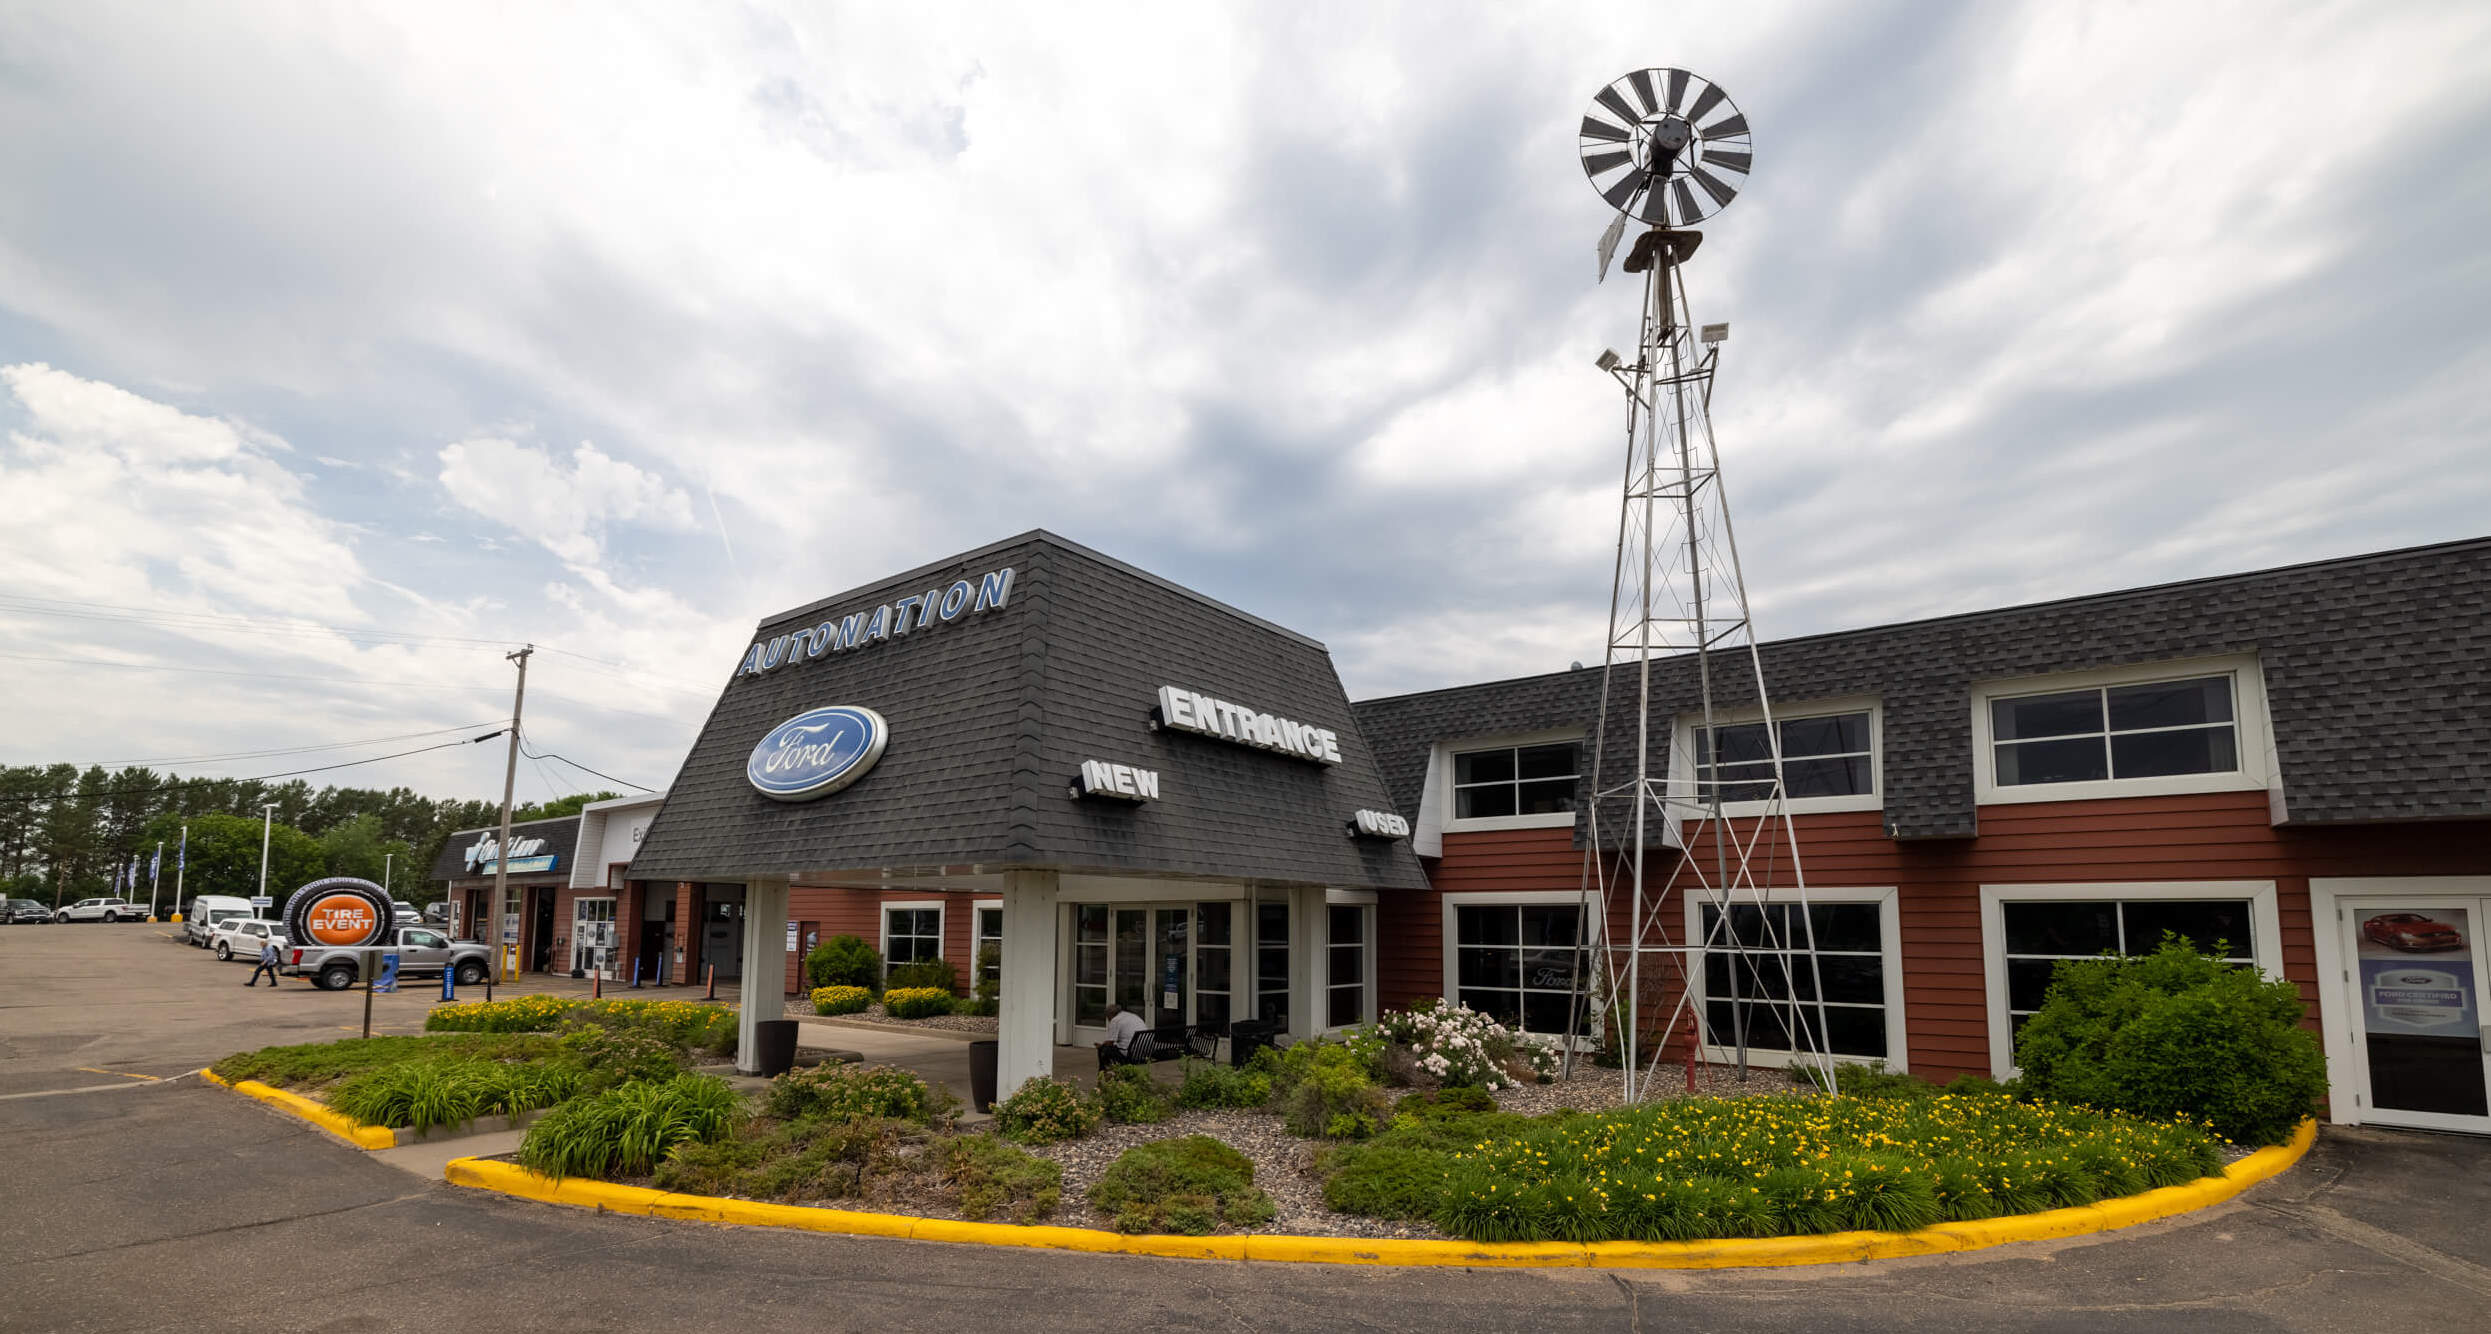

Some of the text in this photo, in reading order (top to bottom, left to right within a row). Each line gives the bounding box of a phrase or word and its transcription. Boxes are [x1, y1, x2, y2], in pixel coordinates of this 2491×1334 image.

[737, 567, 1016, 677] AUTONATION
[1159, 685, 1342, 763] ENTRANCE
[765, 722, 844, 774] Ford
[1081, 760, 1159, 799] NEW
[1355, 809, 1410, 837] USED
[312, 919, 372, 930] EVENT
[321, 908, 364, 919] TIRE
